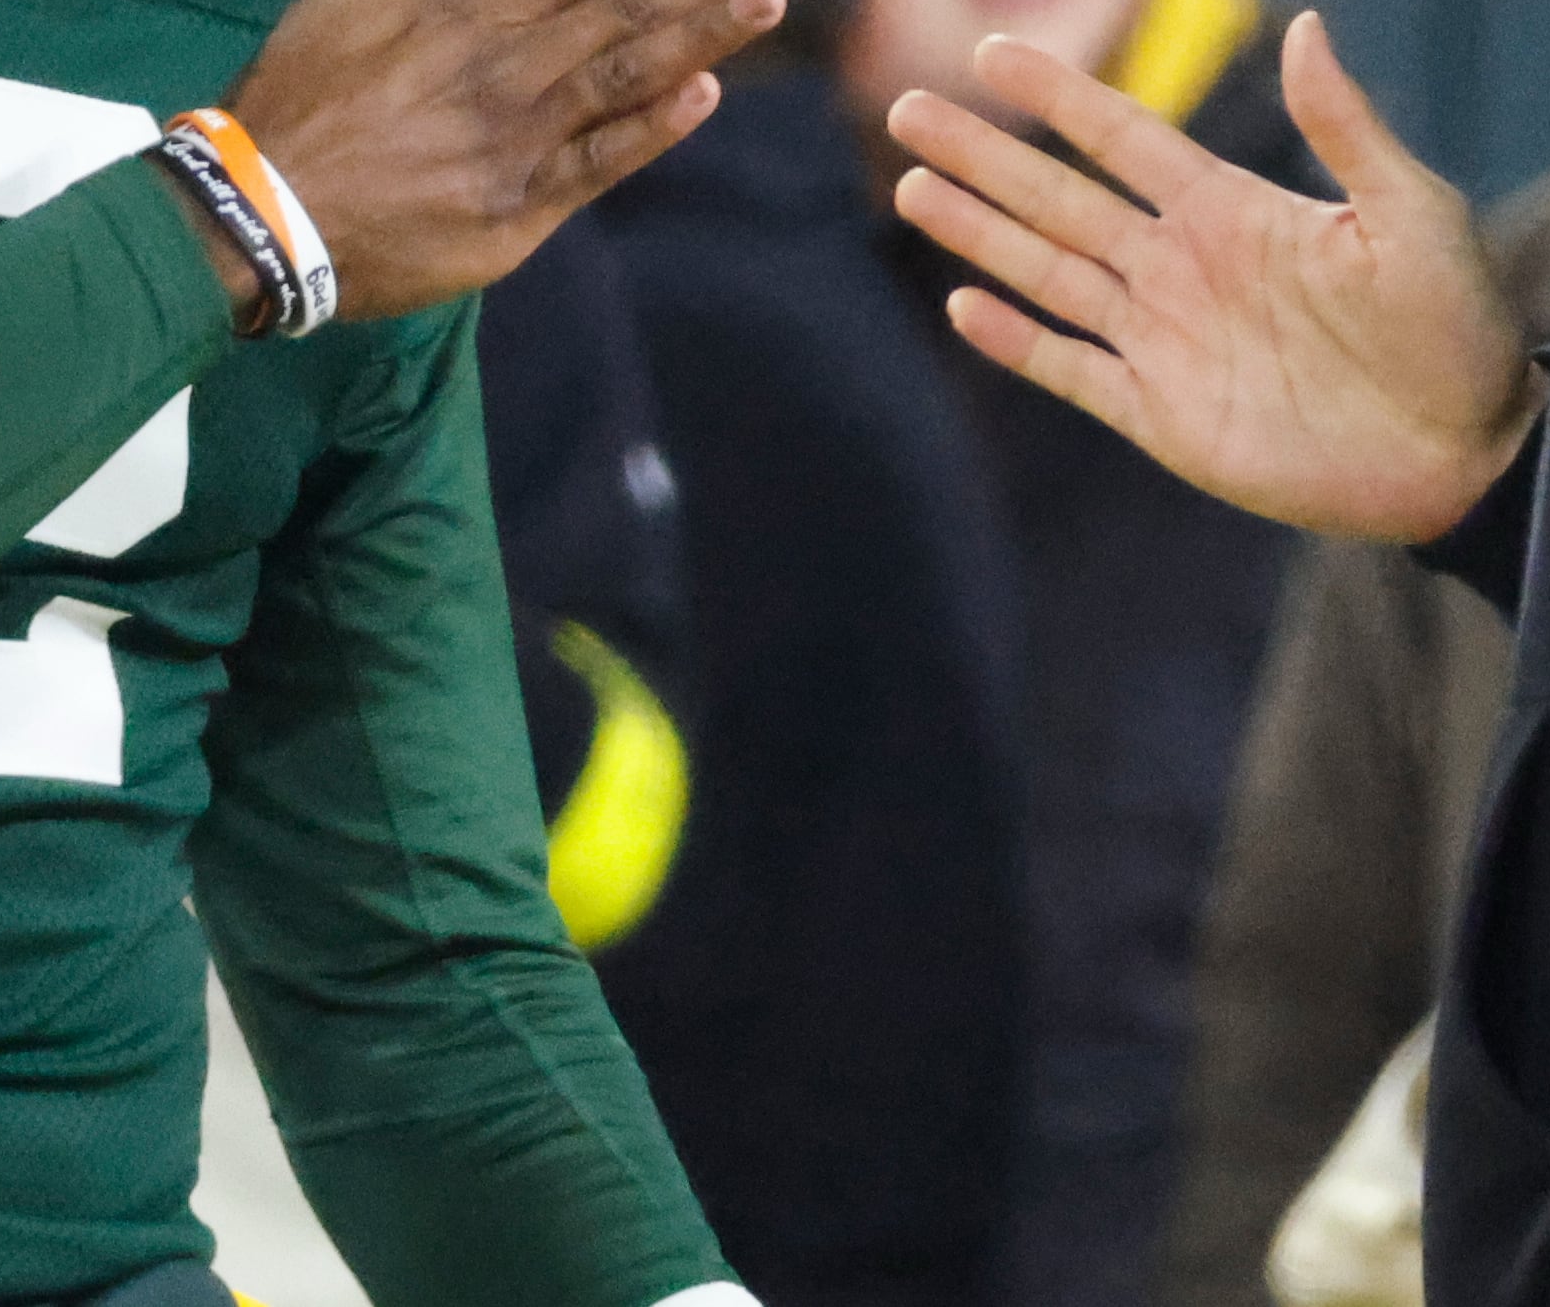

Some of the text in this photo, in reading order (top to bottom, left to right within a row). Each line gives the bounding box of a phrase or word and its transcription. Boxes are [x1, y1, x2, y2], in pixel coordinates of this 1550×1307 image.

[197, 171, 237, 200] will
[217, 201, 269, 246] guide
[255, 248, 286, 282] you
